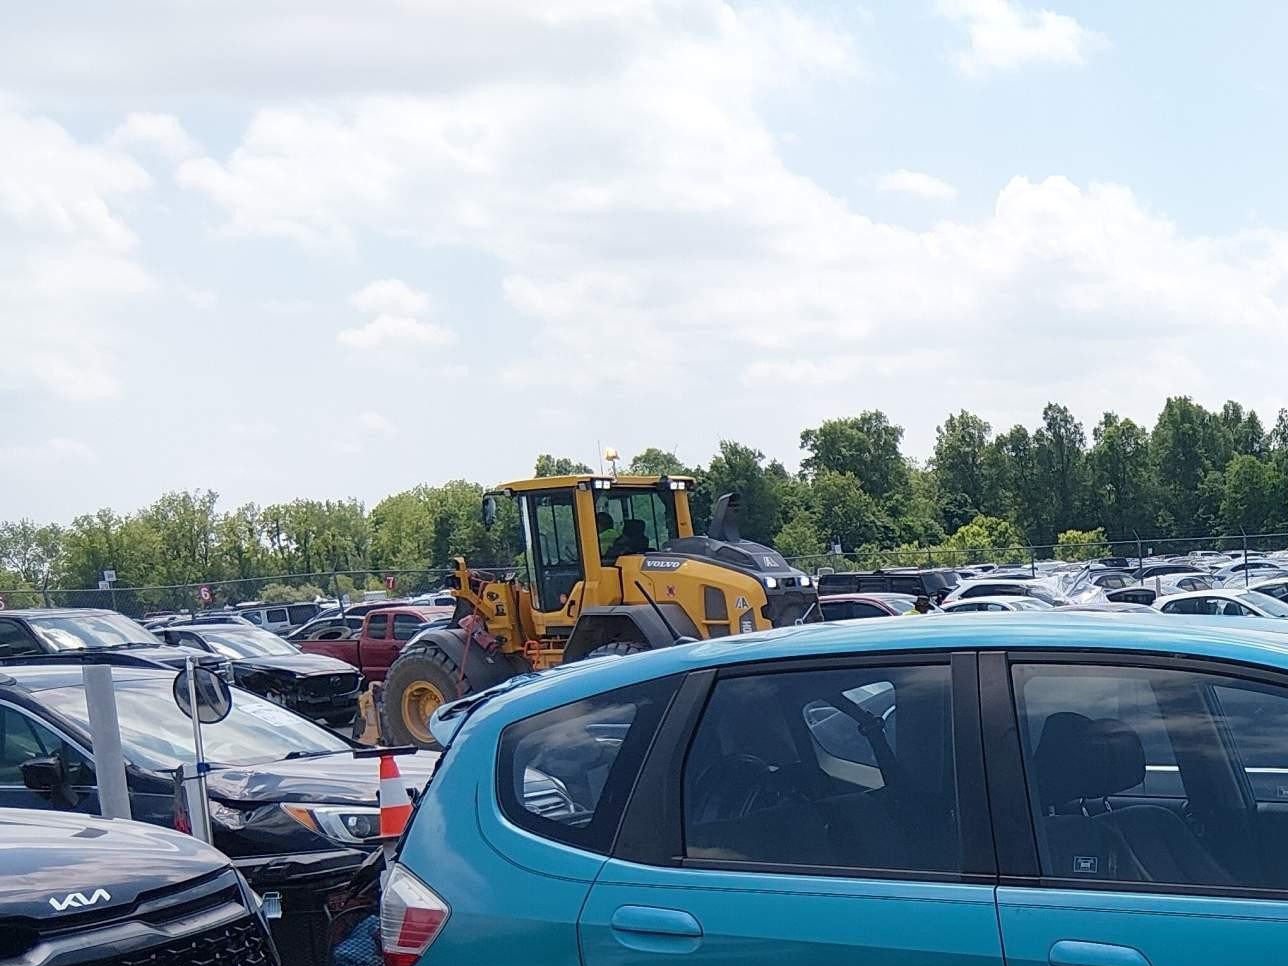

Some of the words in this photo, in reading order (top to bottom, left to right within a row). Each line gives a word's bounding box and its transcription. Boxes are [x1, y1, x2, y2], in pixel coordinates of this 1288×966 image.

[647, 560, 681, 568] VOLVO
[386, 576, 395, 589] 7
[201, 587, 210, 600] 6
[48, 888, 112, 911] KIA
